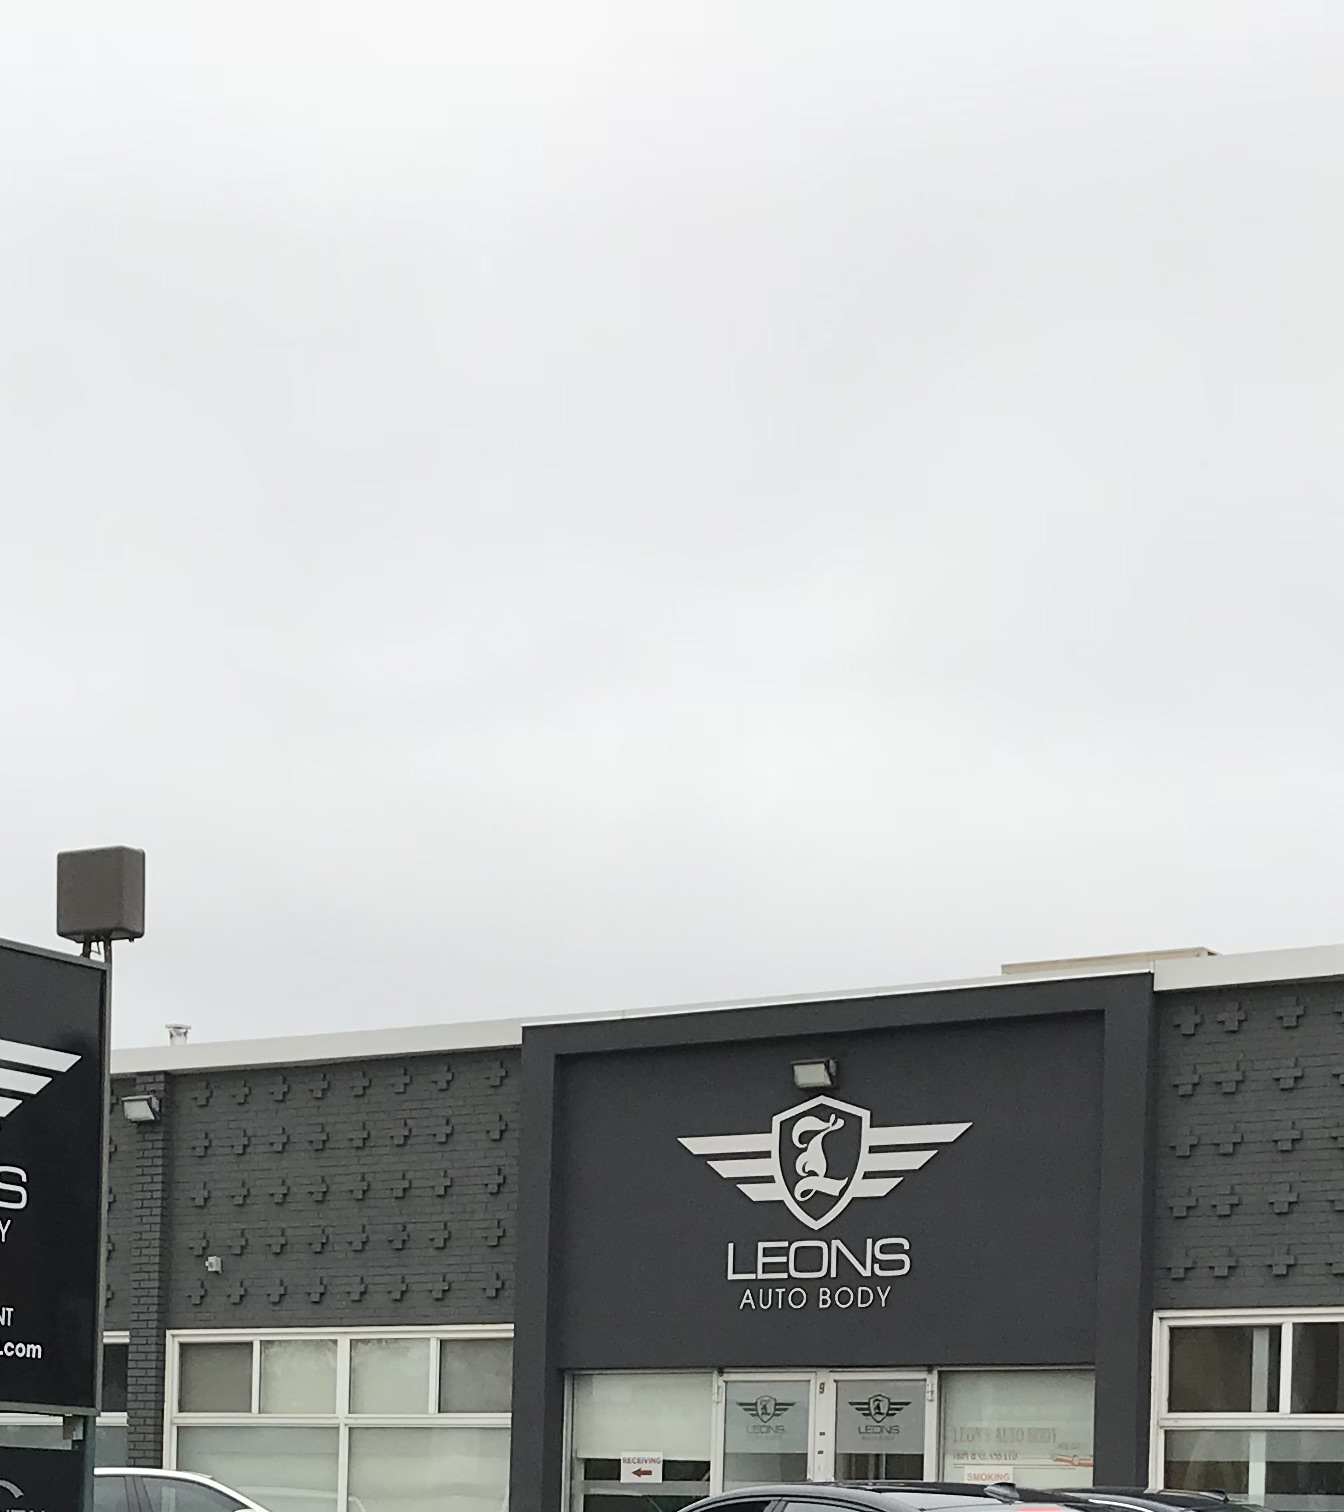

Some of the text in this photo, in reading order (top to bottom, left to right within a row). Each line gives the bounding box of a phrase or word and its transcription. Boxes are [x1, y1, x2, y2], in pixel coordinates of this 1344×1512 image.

[727, 1237, 910, 1281] LEONS
[739, 1286, 891, 1310] AUTO BODY
[746, 1424, 785, 1434] LEONS
[858, 1425, 900, 1435] LEONS
[967, 1473, 1010, 1481] SMOKING
